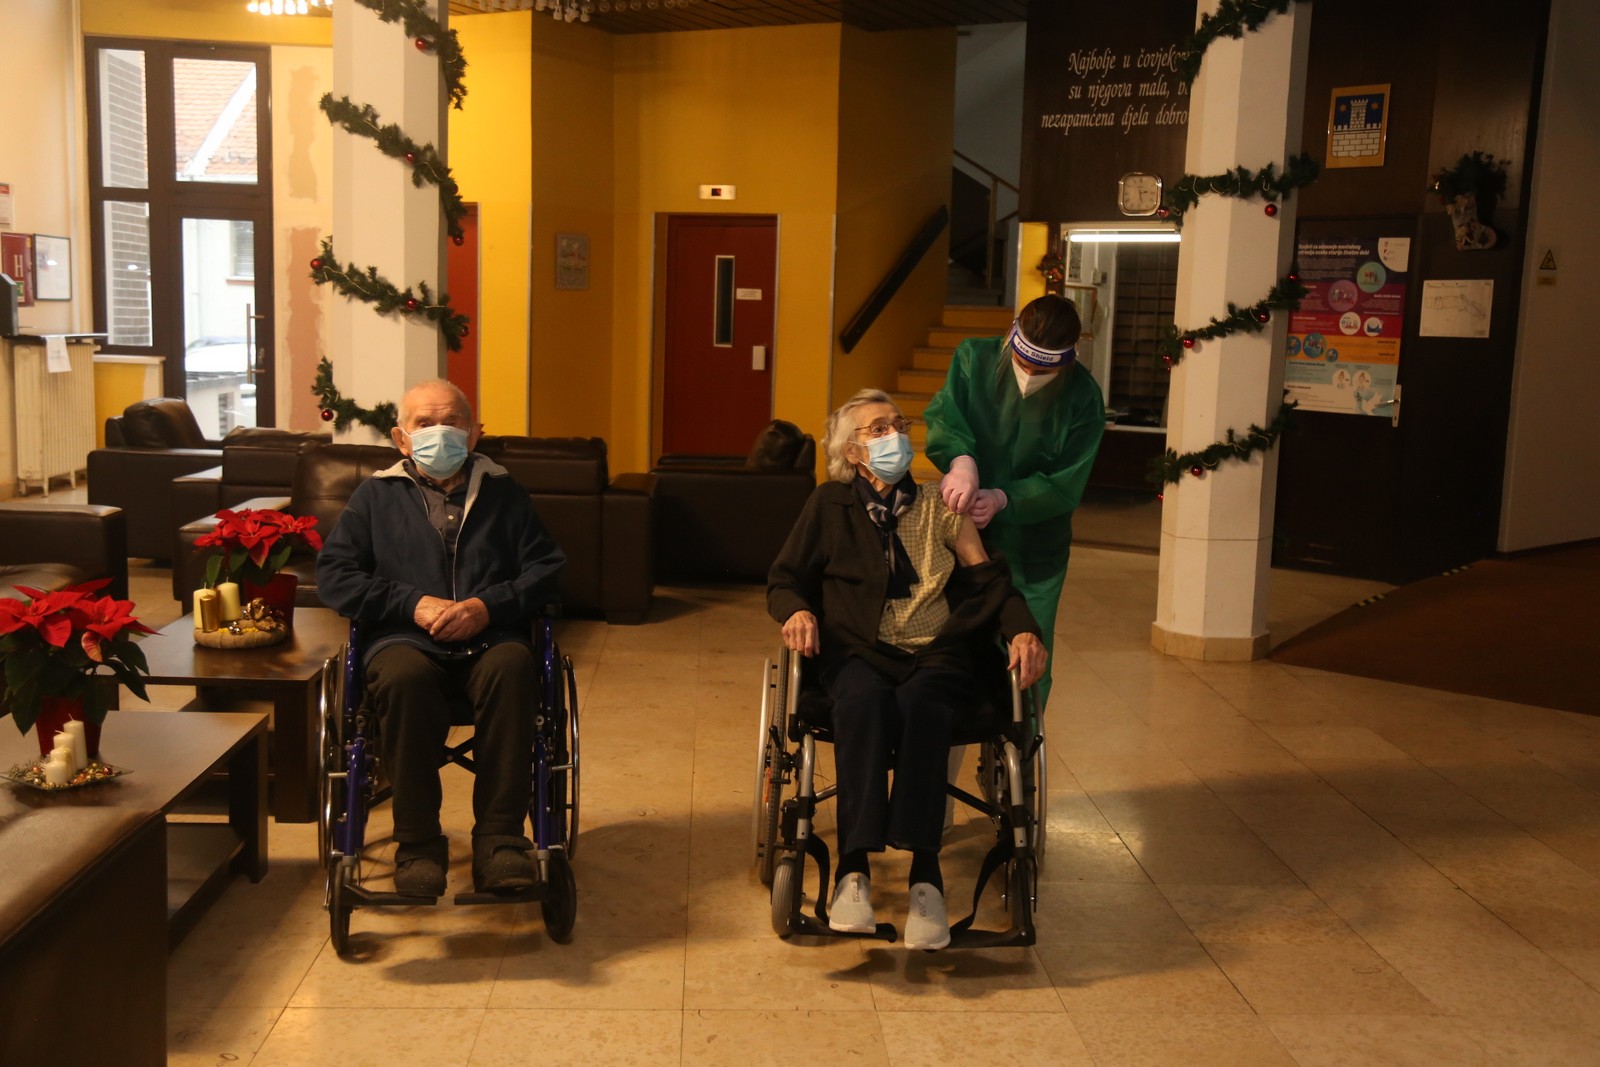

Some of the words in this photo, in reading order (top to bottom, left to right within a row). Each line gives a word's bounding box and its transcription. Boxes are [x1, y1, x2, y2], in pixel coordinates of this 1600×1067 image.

[1068, 47, 1116, 79] Najbolje
[1123, 55, 1131, 69] u
[1068, 85, 1082, 100] su
[1088, 80, 1132, 107] njegova
[1139, 74, 1170, 99] mala,
[1041, 107, 1115, 136] nezapamćena
[1121, 103, 1149, 135] djela
[1017, 341, 1030, 354] Face
[1030, 351, 1054, 362] Shield
